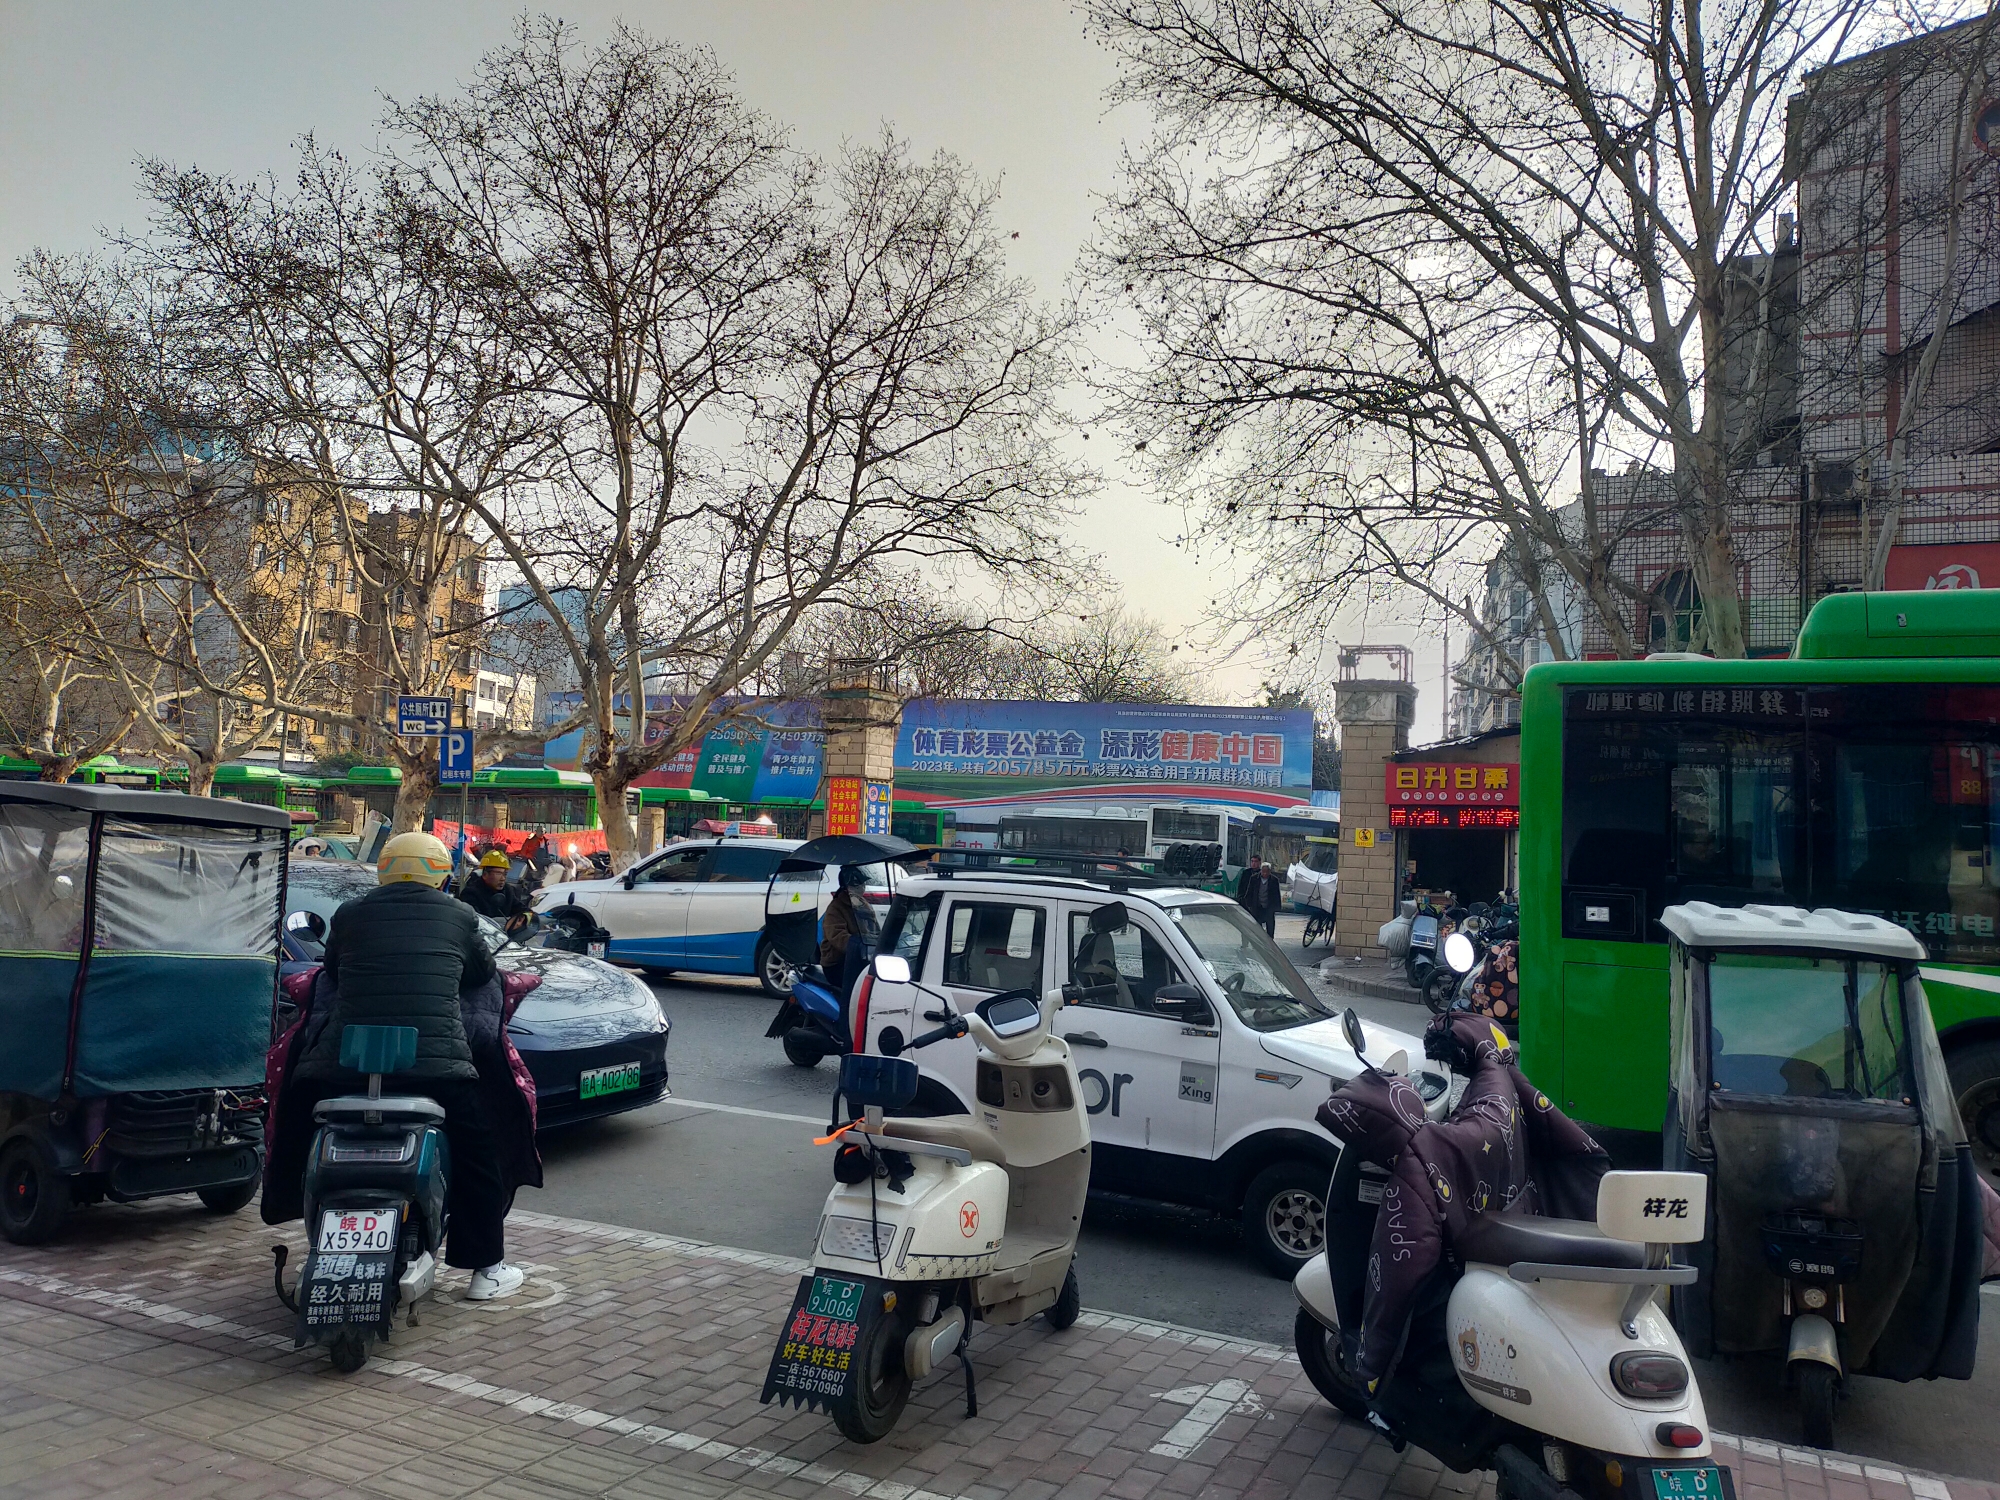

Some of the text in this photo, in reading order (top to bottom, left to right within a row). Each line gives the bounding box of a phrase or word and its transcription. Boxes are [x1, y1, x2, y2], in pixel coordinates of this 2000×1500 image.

[401, 702, 430, 717] 公共厕所
[406, 722, 423, 731] WC
[448, 734, 465, 767] P
[913, 728, 1283, 766] 体育彩票公益金 添彩健康中国
[712, 753, 746, 764] 全民健身
[772, 754, 816, 765] 青少年体育
[442, 769, 471, 779] 出租车专用
[708, 764, 750, 775] 普及与推广
[770, 764, 815, 776] 推广与提升
[832, 779, 858, 789] 公交场站
[832, 791, 858, 800] 社会车辆
[831, 803, 857, 812] 严禁入内
[831, 814, 857, 824] 否则后果
[868, 804, 877, 834] 场站
[1860, 909, 1995, 938] 沃纯电
[1181, 1085, 1212, 1102] Xing
[1643, 1197, 1689, 1218] 祥龙
[323, 1231, 388, 1250] X5940
[309, 1282, 384, 1305] 经久耐用
[811, 1295, 855, 1318] 9J006
[778, 1362, 847, 1384] 一店:5676607
[774, 1373, 844, 1397] 二店:5670960
